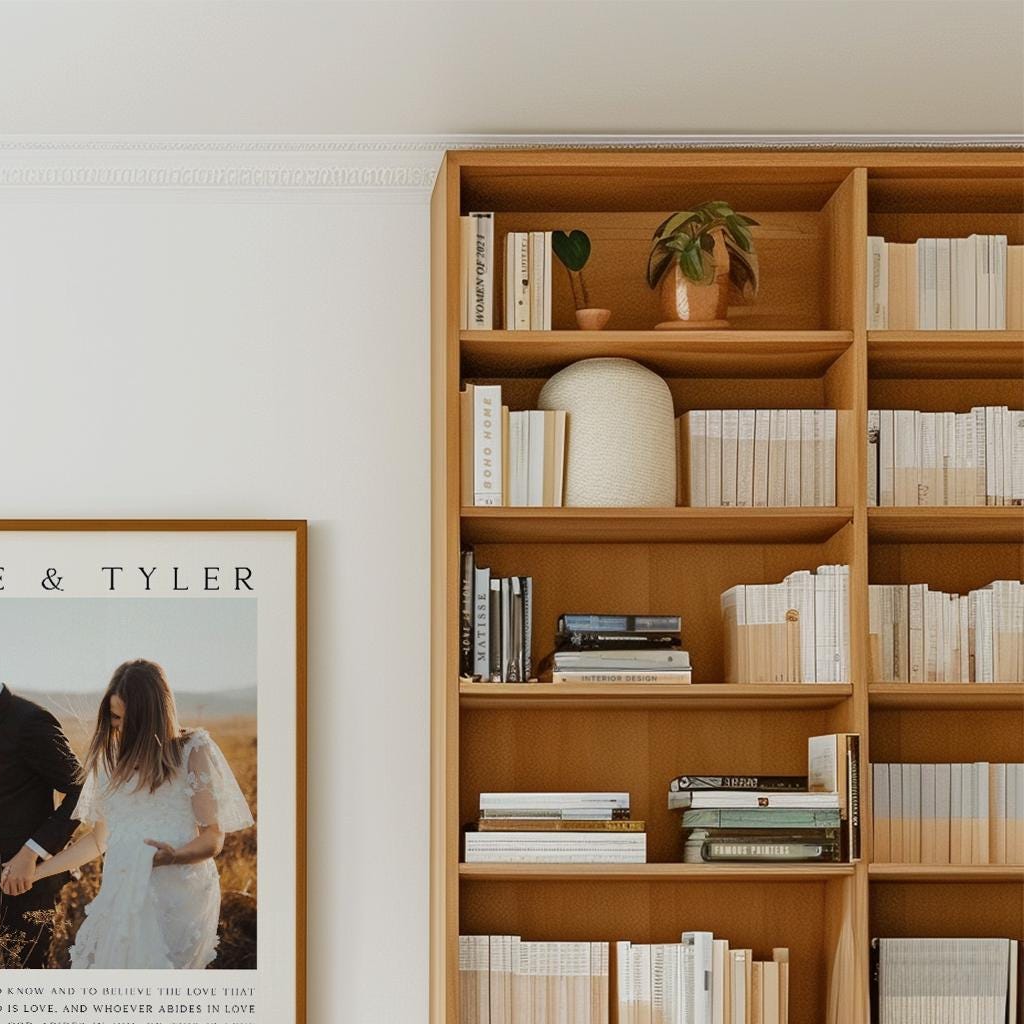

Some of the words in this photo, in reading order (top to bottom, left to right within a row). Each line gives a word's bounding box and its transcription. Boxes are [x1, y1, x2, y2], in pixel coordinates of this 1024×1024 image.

[476, 258, 486, 276] OF
[475, 278, 485, 323] WOMEN
[483, 398, 492, 440] HOME
[483, 447, 492, 489] BOHO
[41, 567, 65, 592] &
[101, 566, 254, 591] TYLER
[477, 593, 487, 662] MATISSE
[714, 845, 749, 856] FAMOUS
[750, 845, 790, 856] PAINTERS
[7, 986, 45, 996] KNOW
[51, 987, 76, 996] AND
[80, 987, 98, 996] TO
[102, 987, 152, 996] BELIEVE
[157, 987, 181, 997] THE
[186, 987, 217, 997] LOVE
[222, 987, 256, 997] THAT
[5, 1004, 19, 1013] IS
[62, 1004, 88, 1014] AND
[92, 1004, 153, 1014] WHOEVER
[157, 1004, 202, 1014] ABIDES
[207, 1004, 220, 1014] IN
[224, 1004, 256, 1014] LOVE
